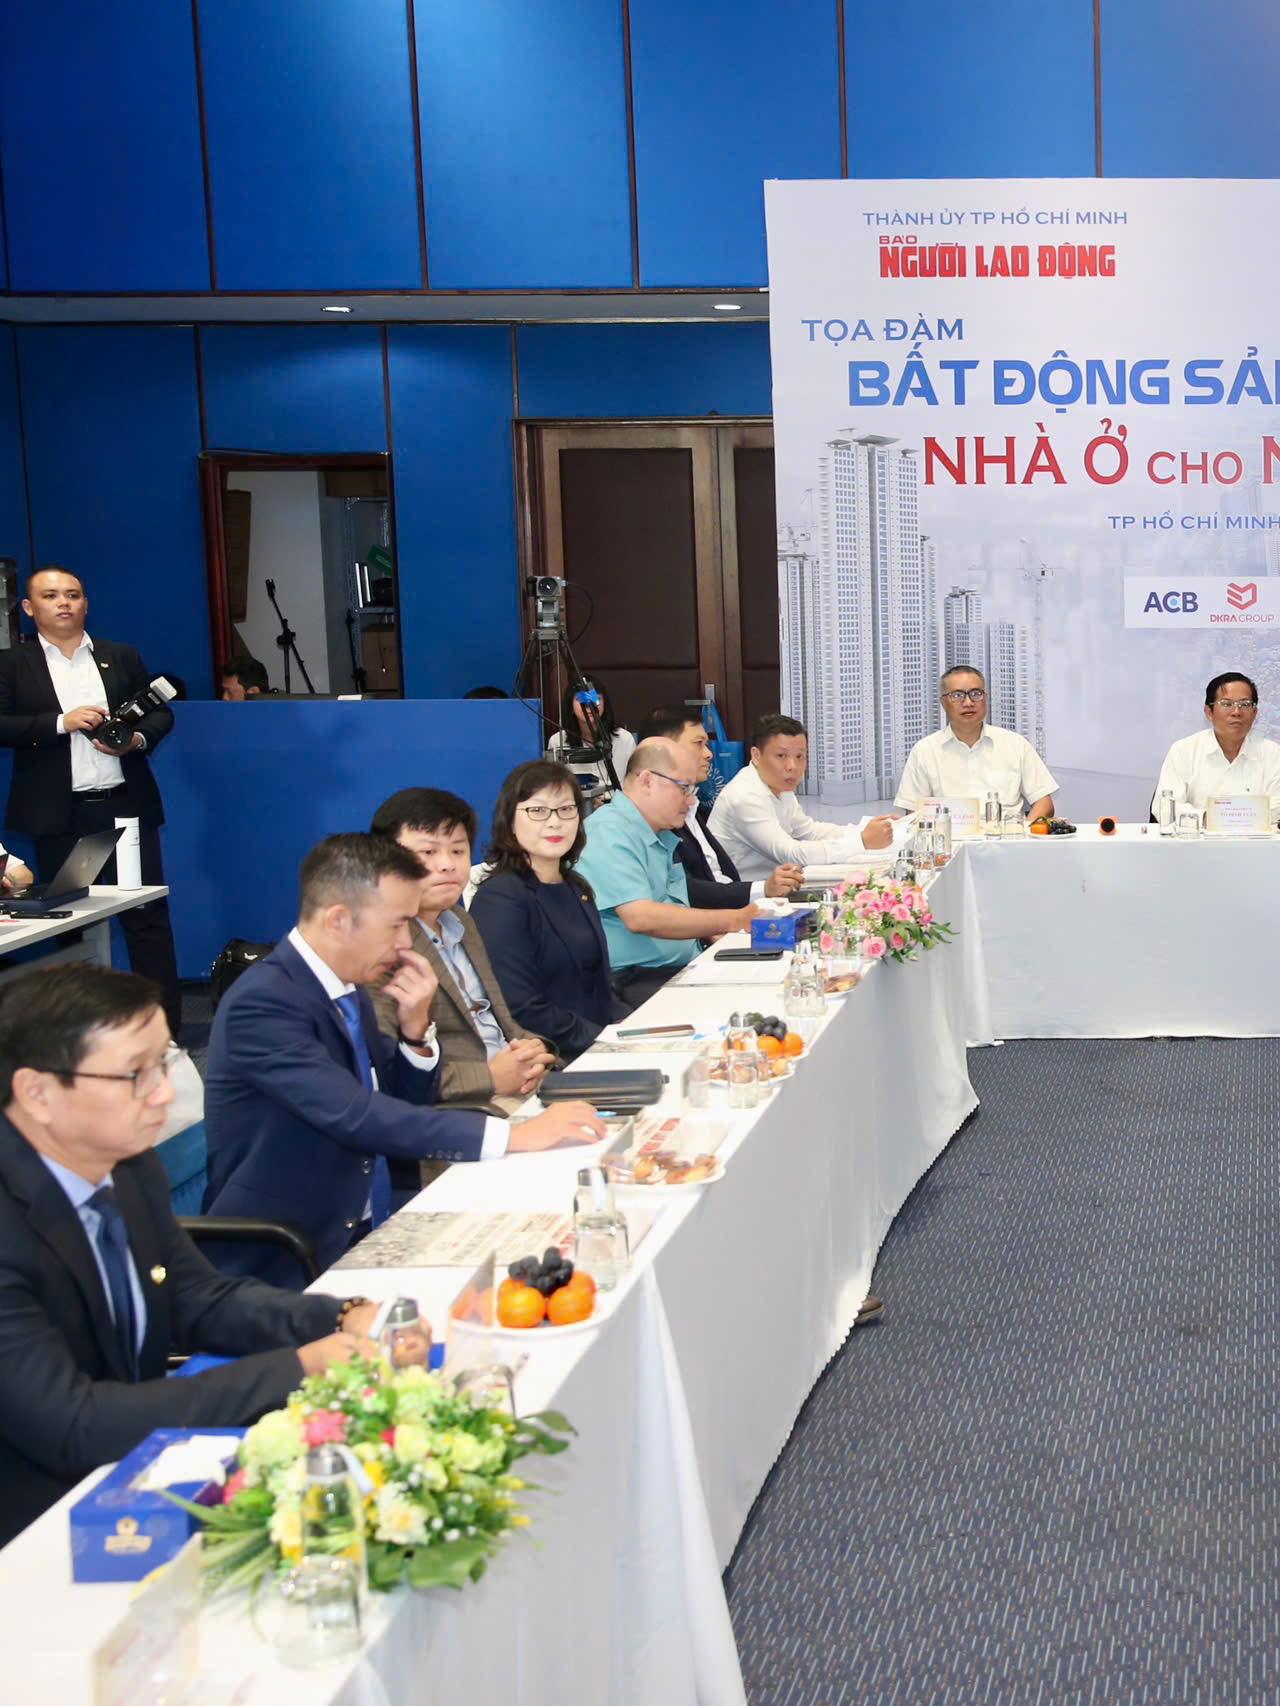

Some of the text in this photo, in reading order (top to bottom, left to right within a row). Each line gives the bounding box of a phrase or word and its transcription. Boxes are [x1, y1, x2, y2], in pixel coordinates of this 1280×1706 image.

[863, 206, 1128, 225] THÀNH ỦY TP HỒ CHÍ MINH
[879, 241, 1116, 280] NGƯỜI LAO ĐỘNG
[802, 313, 965, 347] TỌA ĐÀM
[849, 342, 980, 406] BẤT
[993, 350, 1170, 413] ĐỘNG
[924, 422, 1067, 485] NHÀ
[1083, 417, 1130, 485] Ở
[1147, 451, 1243, 485] CHO
[1108, 515, 1135, 529] TP
[1142, 510, 1174, 529] HỒ
[1180, 512, 1218, 529] CHÍ
[1143, 591, 1199, 613] ACB
[1210, 614, 1275, 623] DKRA GROUP
